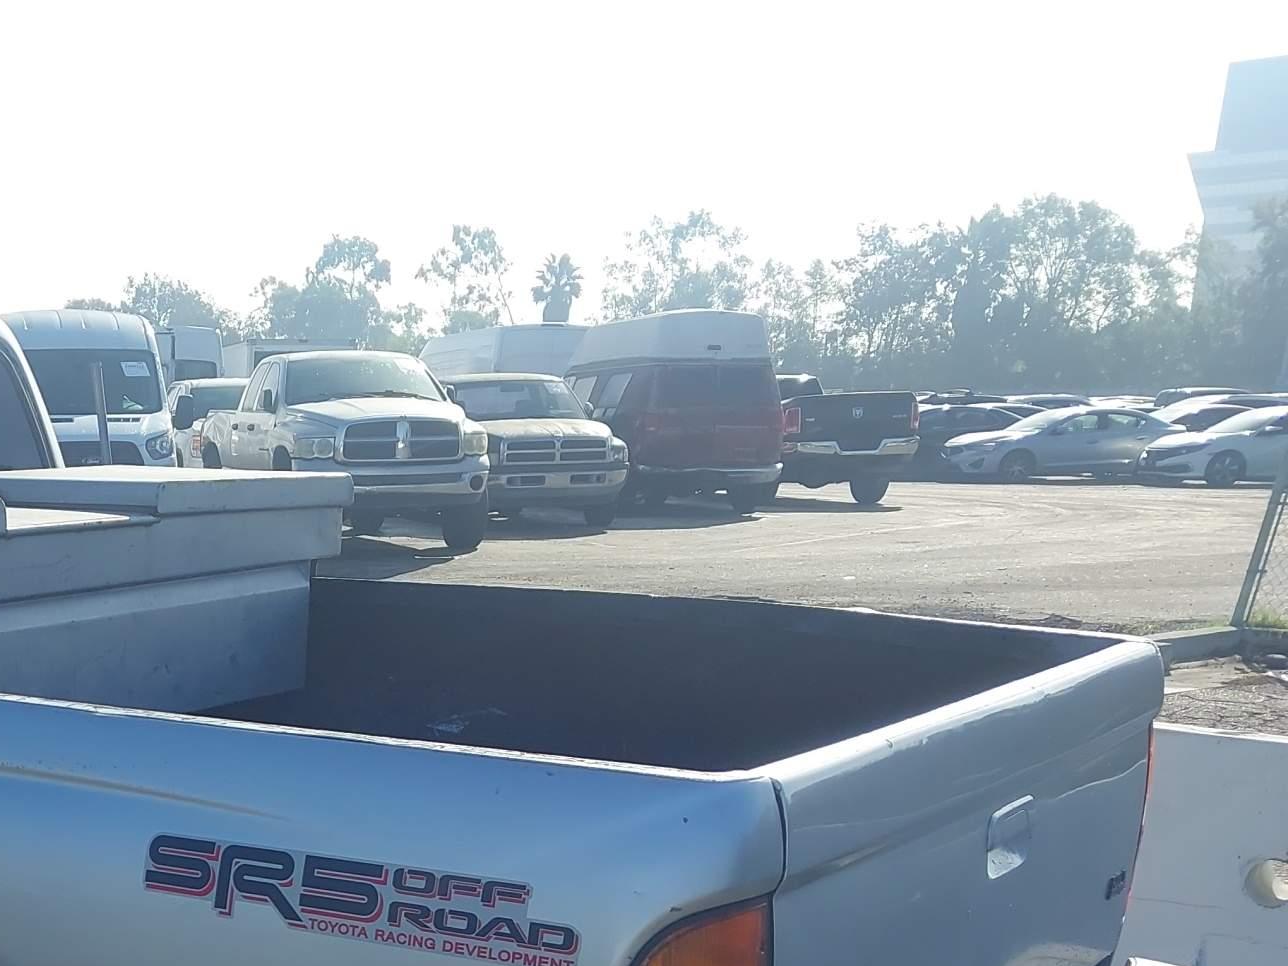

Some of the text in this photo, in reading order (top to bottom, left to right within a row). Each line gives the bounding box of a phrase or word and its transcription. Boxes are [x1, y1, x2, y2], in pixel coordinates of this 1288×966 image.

[144, 833, 531, 929] SR5 OFF
[308, 917, 368, 939] TOYOTA
[374, 928, 437, 951] RACING
[387, 900, 580, 956] ROAD
